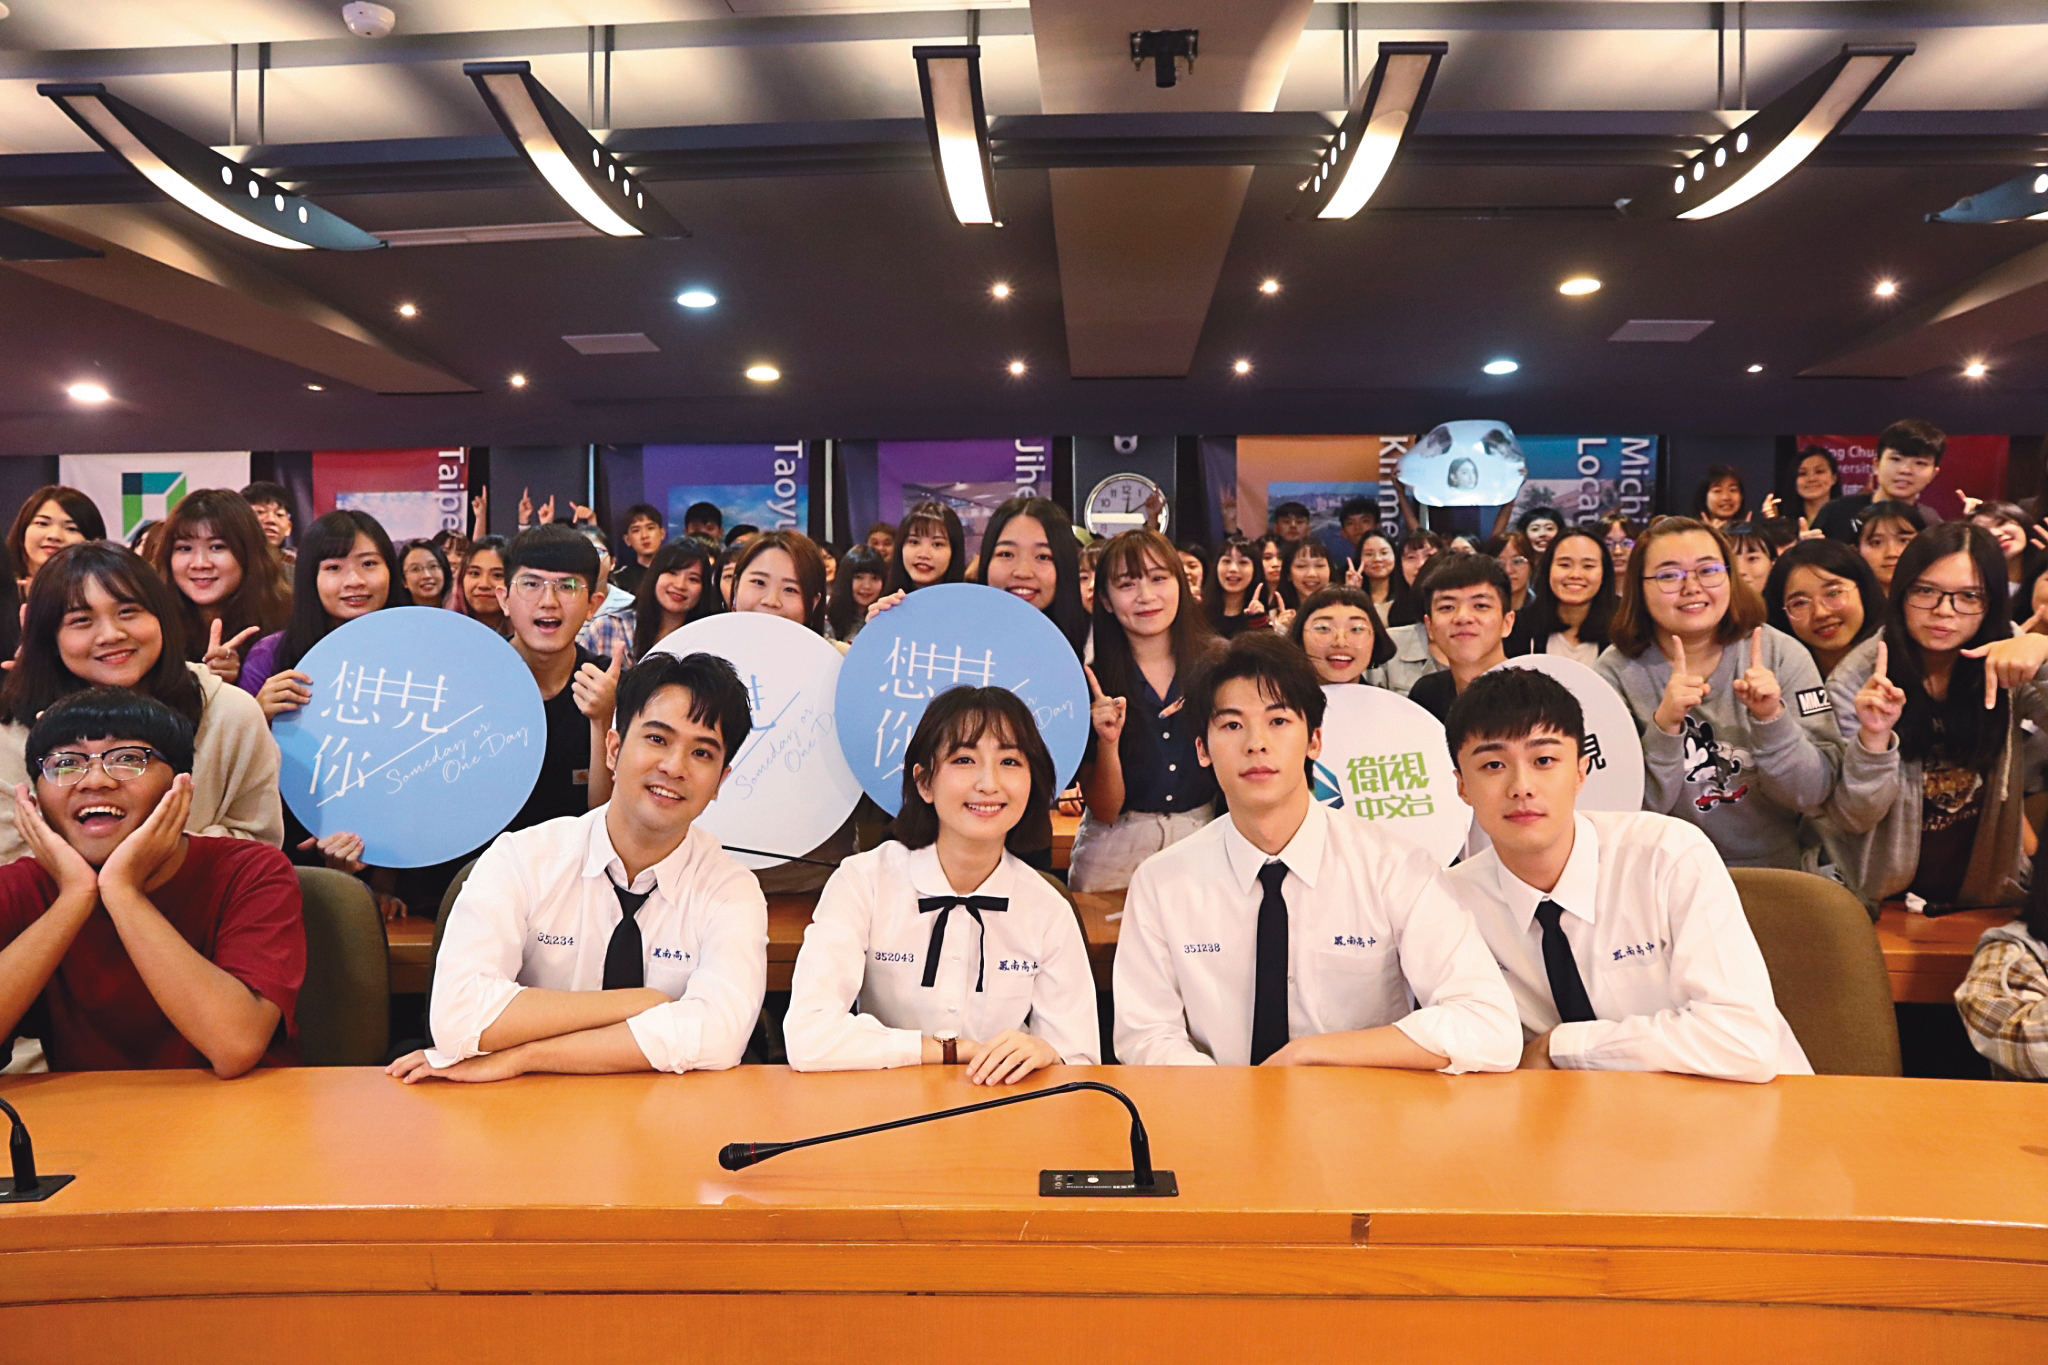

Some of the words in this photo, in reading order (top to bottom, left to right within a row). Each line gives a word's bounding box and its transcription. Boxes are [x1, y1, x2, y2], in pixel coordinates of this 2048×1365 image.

[438, 446, 465, 532] Taipe
[1101, 498, 1111, 508] 10
[1122, 485, 1131, 495] 12
[320, 660, 449, 733] 想見
[1032, 699, 1075, 730] Day
[309, 734, 372, 797] 你
[386, 738, 467, 795] Someday
[442, 755, 481, 784] One
[479, 727, 529, 758] Day
[735, 727, 802, 800] Someday
[1346, 751, 1430, 795] 衛視
[1355, 793, 1435, 820] 中文台
[874, 951, 915, 963] 352043
[1183, 942, 1221, 954] 351238
